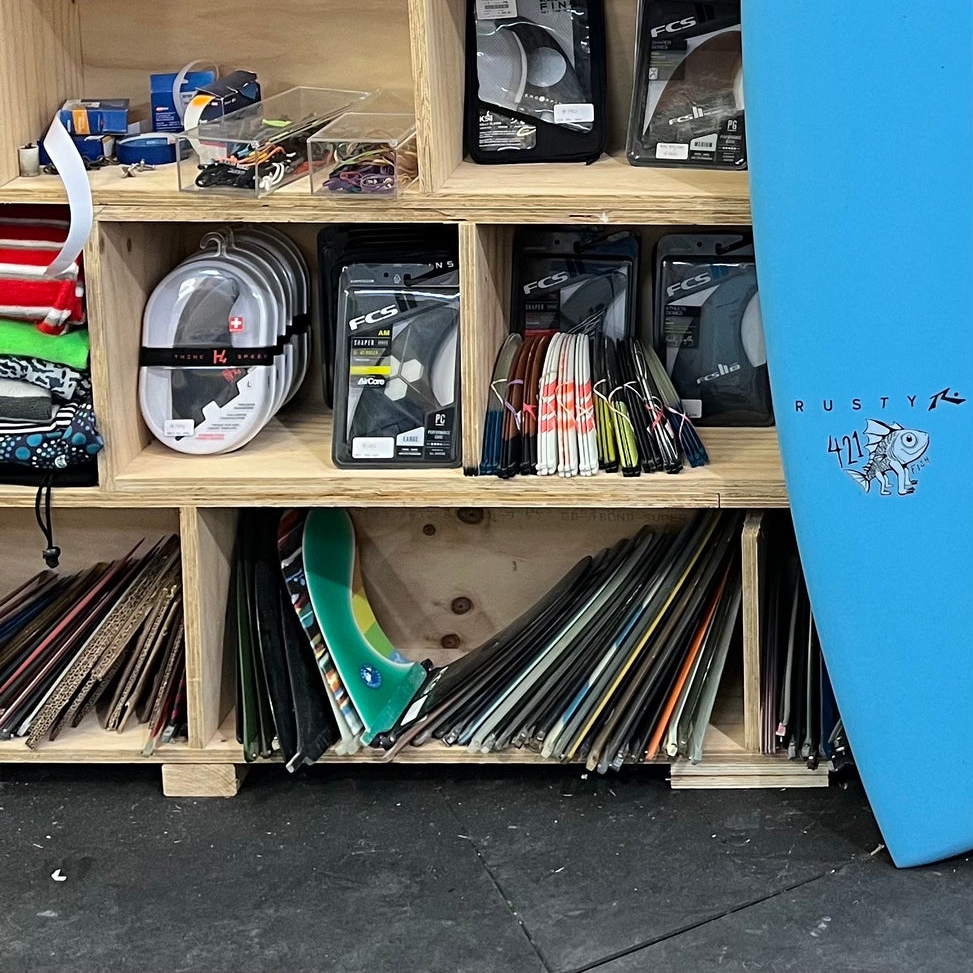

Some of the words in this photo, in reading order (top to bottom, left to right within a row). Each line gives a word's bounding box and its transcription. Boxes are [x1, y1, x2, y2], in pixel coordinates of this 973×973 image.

[651, 16, 696, 38] FCS
[523, 271, 568, 295] FCS
[666, 272, 712, 297] FCS
[349, 304, 398, 330] FCS
[358, 378, 386, 386] AirCore
[795, 396, 916, 412] RUSTY
[435, 414, 446, 424] PC
[827, 430, 864, 468] 421
